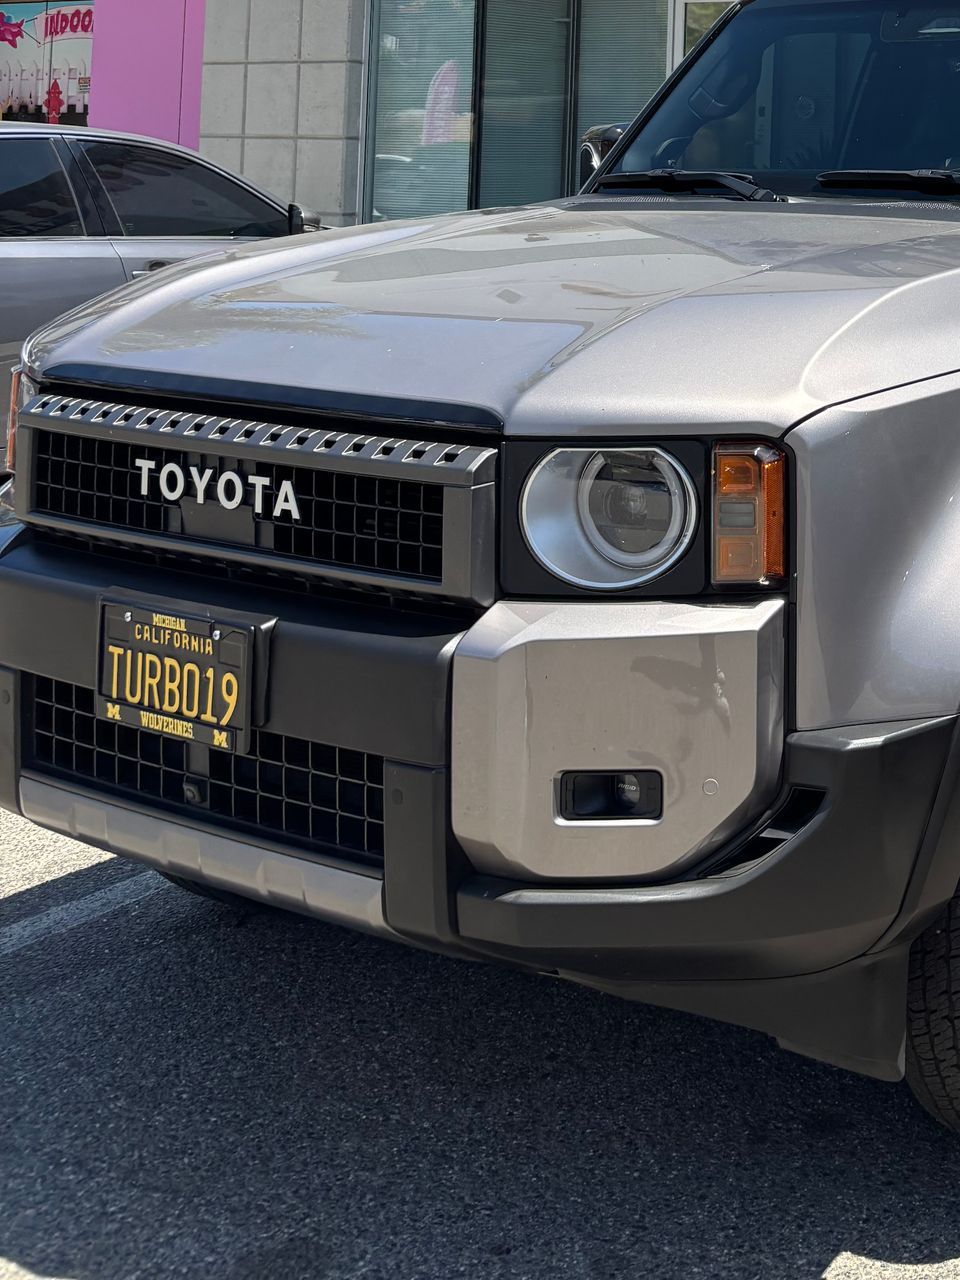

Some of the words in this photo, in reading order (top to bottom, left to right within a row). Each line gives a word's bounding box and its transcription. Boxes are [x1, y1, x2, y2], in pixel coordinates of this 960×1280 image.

[45, 9, 94, 38] INDOO
[135, 459, 300, 520] TOYOTA
[134, 624, 213, 655] CALIFORNIA
